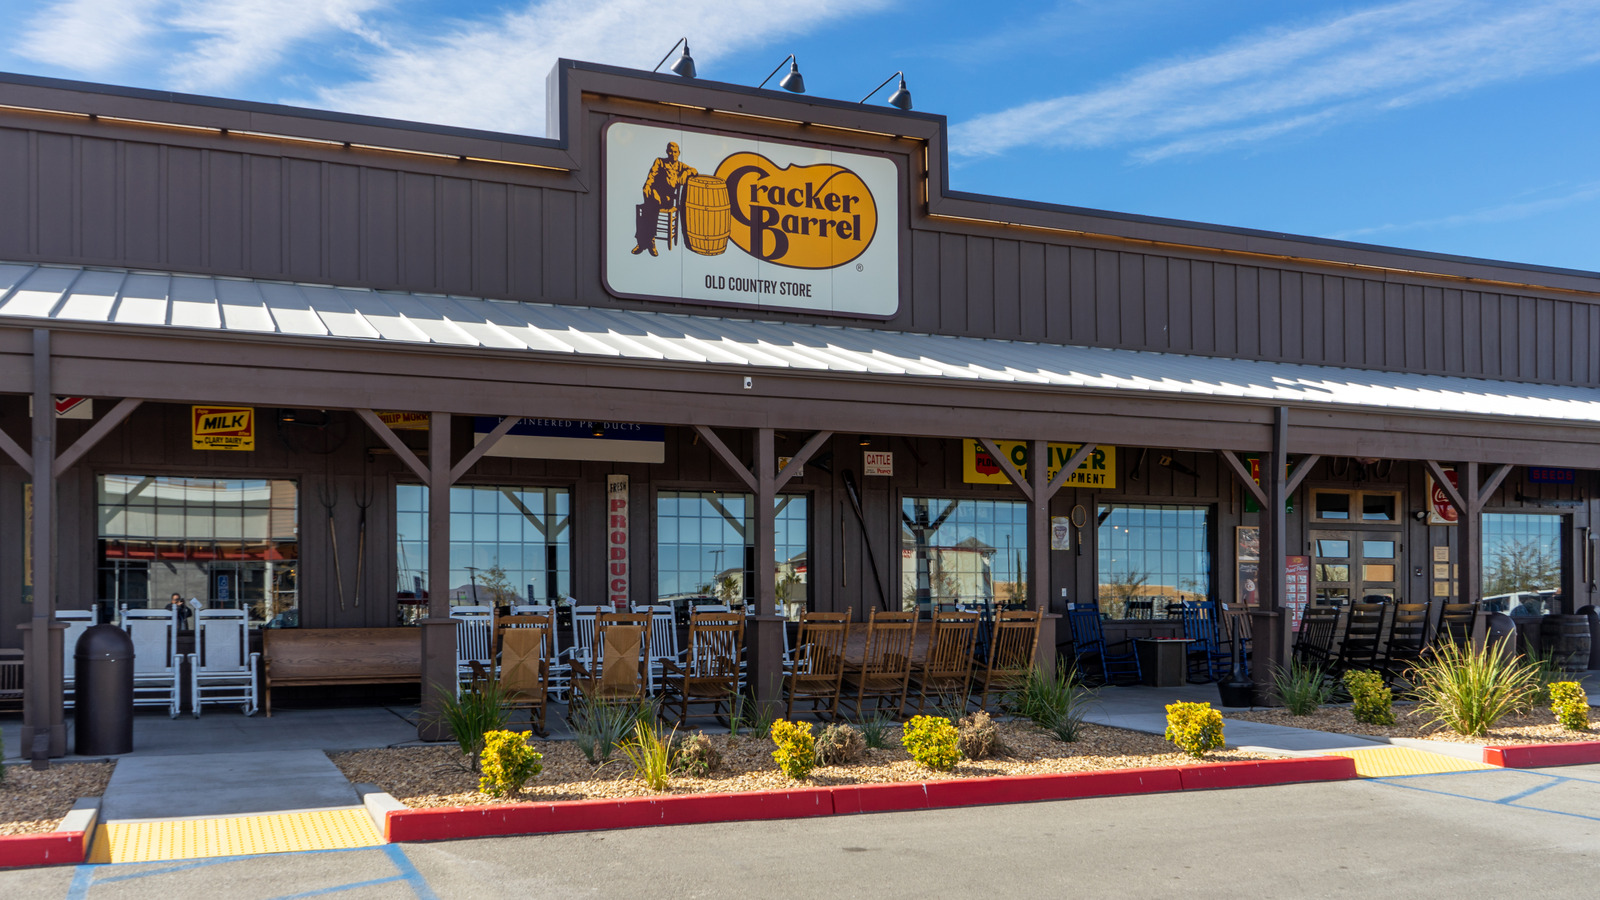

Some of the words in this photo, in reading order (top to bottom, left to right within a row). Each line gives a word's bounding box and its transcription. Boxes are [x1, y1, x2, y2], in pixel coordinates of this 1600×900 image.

[726, 165, 859, 227] Cracker
[749, 204, 861, 261] Barrel
[705, 274, 725, 290] OLD
[728, 276, 777, 294] COUNTRY
[780, 281, 812, 298] STORE
[203, 415, 245, 430] MILK
[498, 417, 572, 428] EINEERED
[580, 420, 641, 431] PRDUCTS
[866, 454, 891, 466] CATTLE
[1533, 470, 1573, 481] SEEDS
[609, 482, 627, 493] FRESH
[610, 498, 627, 609] PRODUCE
